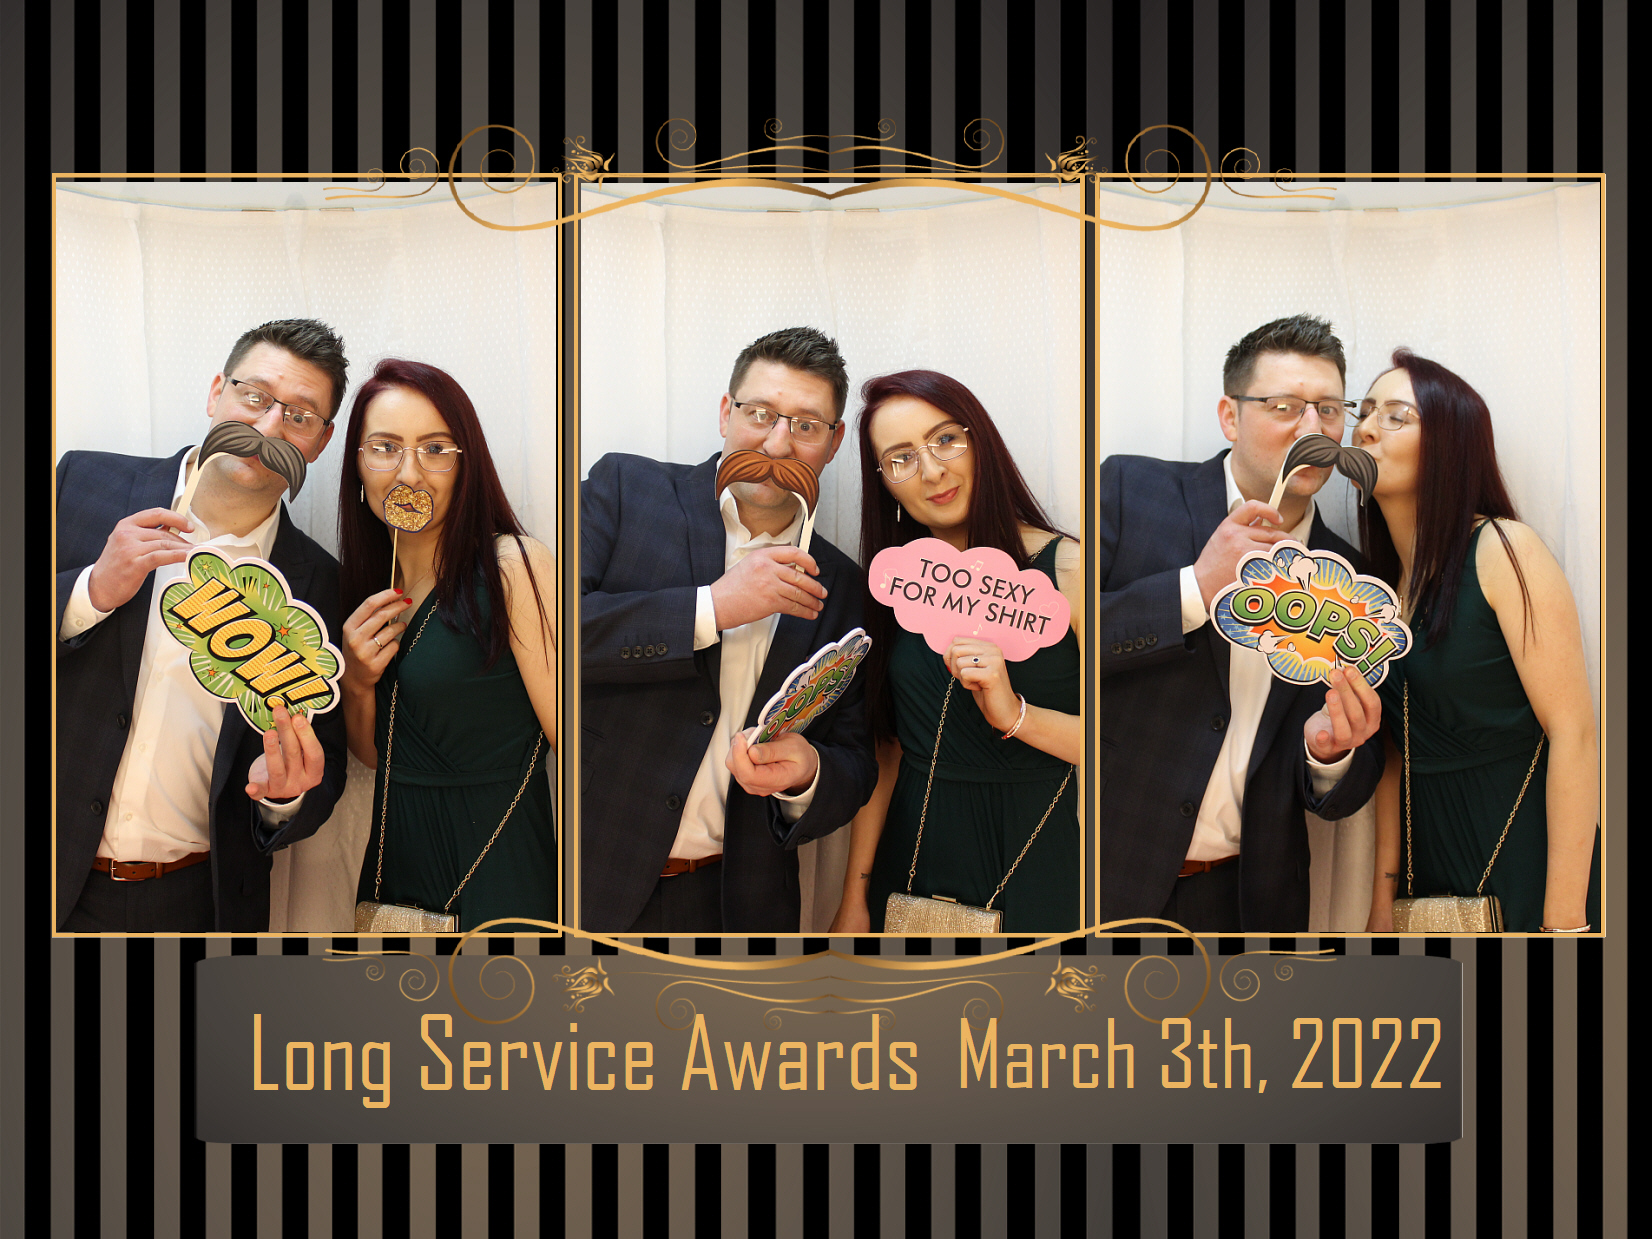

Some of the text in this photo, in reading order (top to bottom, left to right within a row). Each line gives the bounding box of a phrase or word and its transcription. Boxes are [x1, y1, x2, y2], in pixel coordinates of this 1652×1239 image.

[889, 576, 1052, 635] FOR MY SHIRT
[920, 558, 1035, 605] TOO SEXY
[168, 577, 334, 712] WOW!
[1230, 586, 1399, 675] OOPS!
